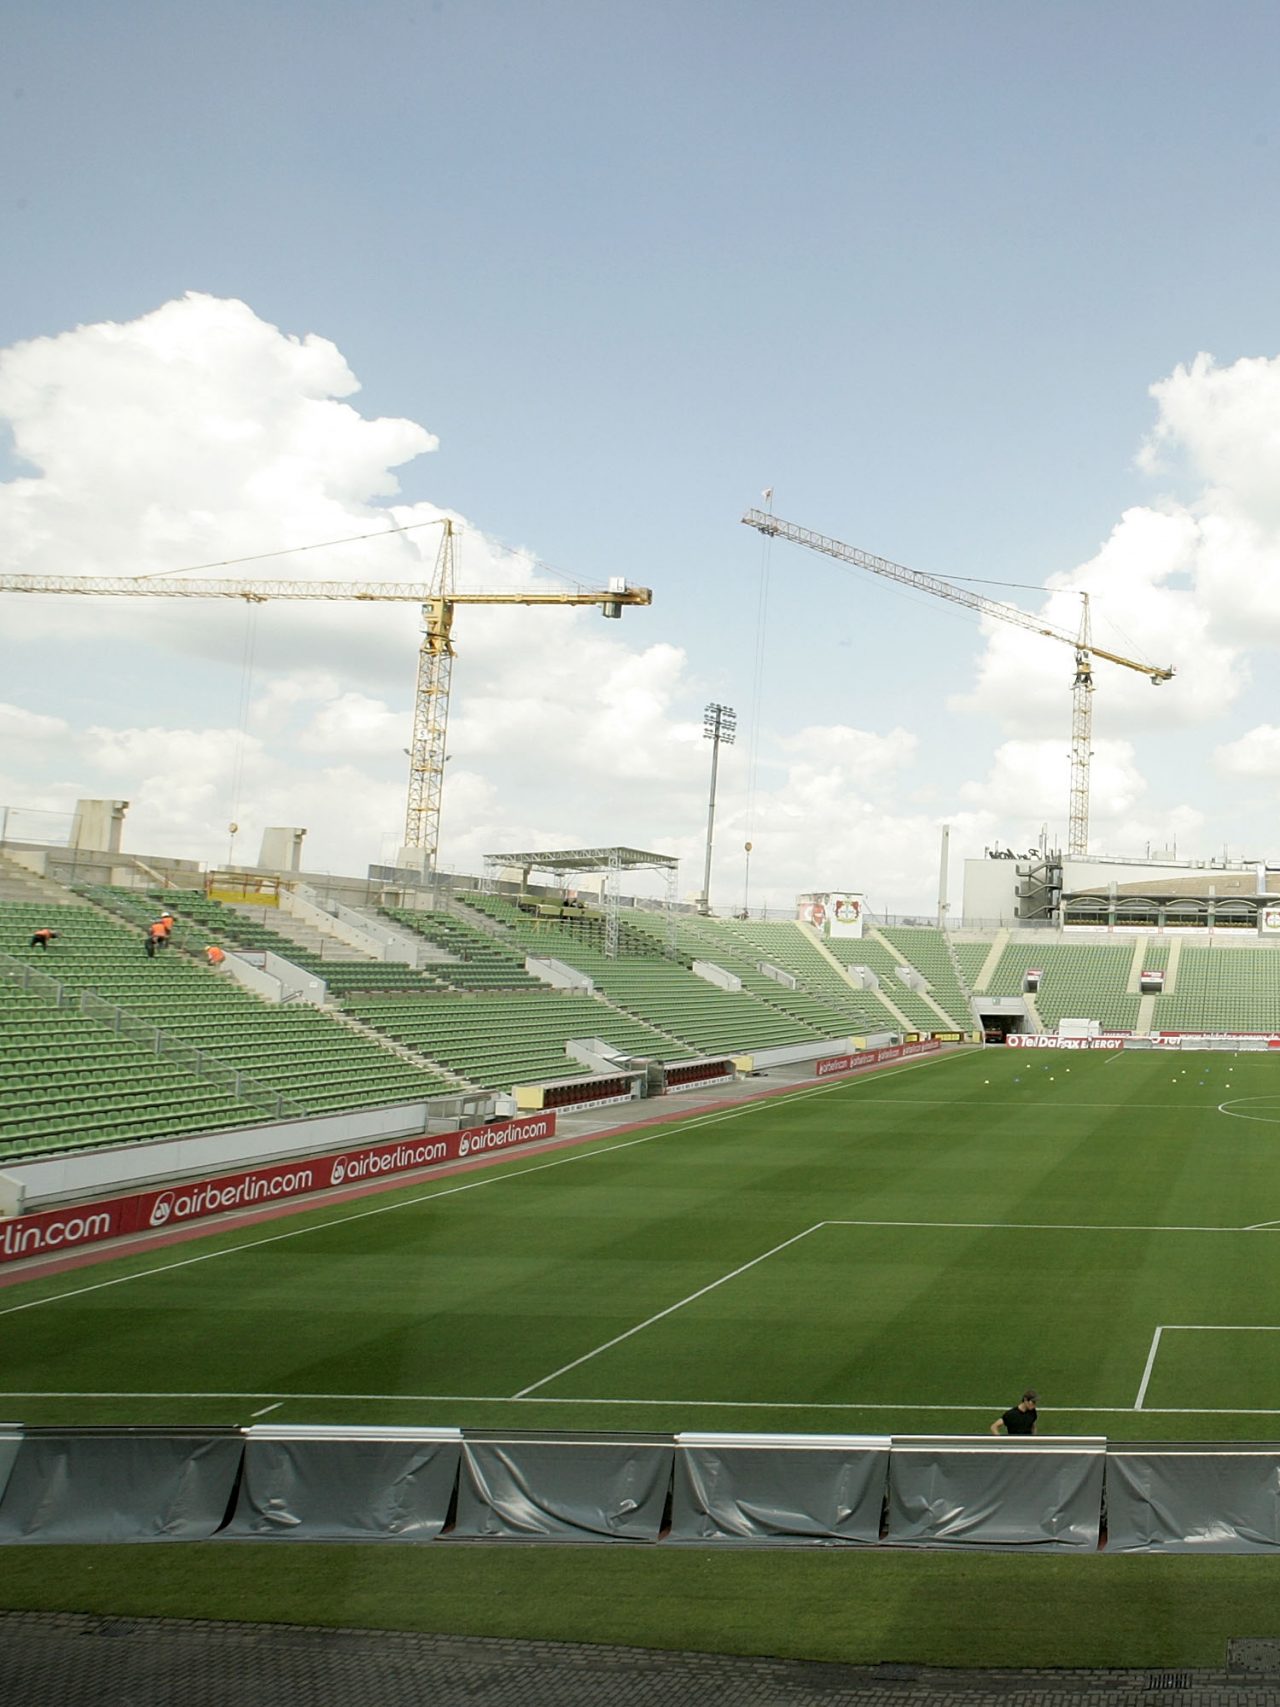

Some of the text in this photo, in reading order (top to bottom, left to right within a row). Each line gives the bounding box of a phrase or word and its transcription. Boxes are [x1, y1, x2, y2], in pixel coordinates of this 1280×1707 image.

[470, 1121, 547, 1151] airberlin.com
[346, 1142, 447, 1178] airberlin.com
[174, 1170, 313, 1217] airberlin.com
